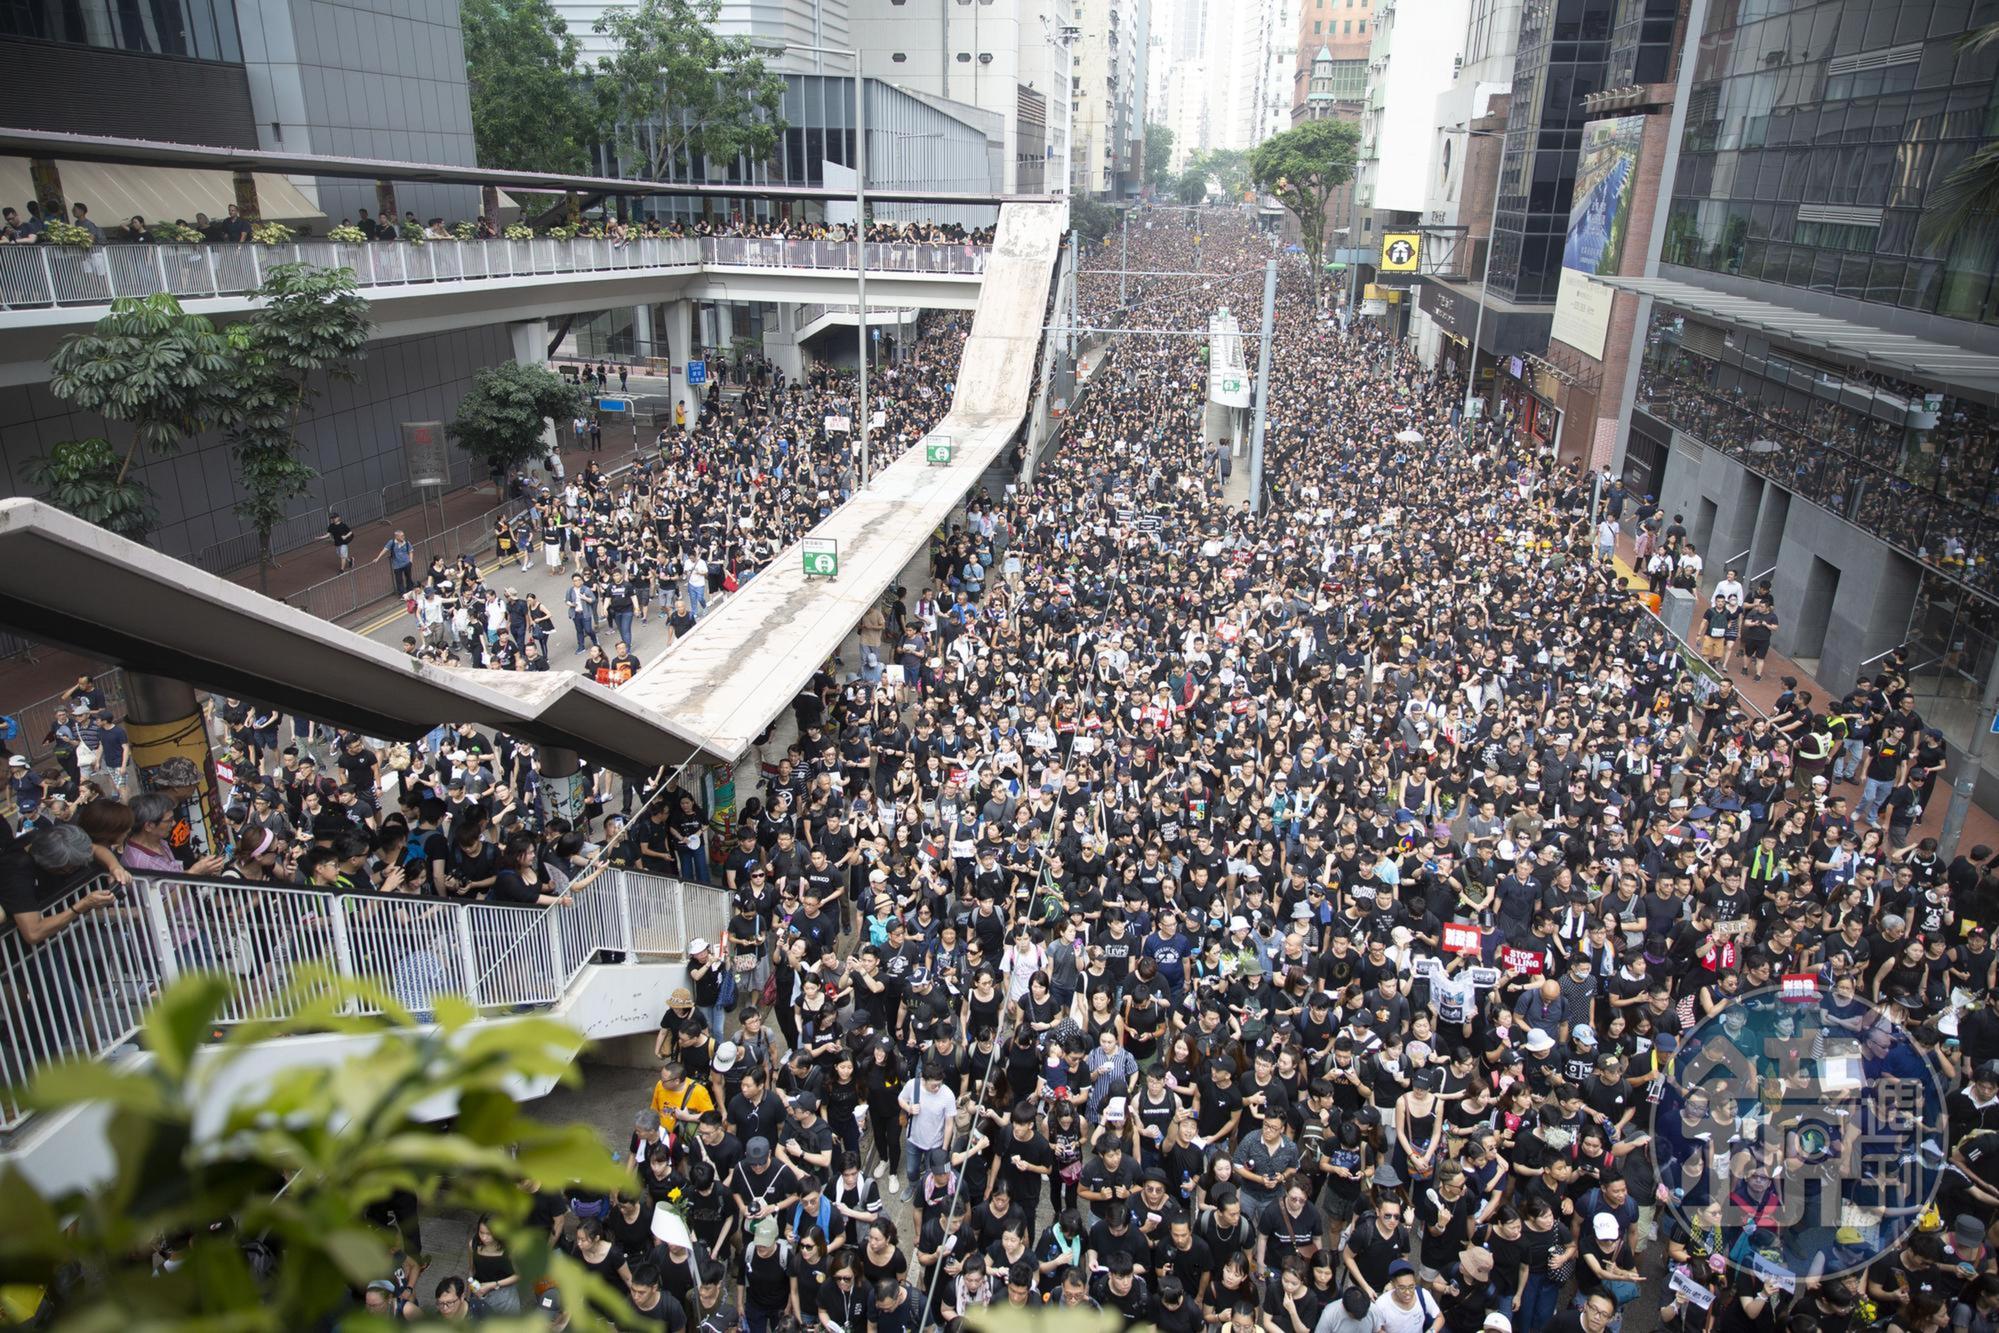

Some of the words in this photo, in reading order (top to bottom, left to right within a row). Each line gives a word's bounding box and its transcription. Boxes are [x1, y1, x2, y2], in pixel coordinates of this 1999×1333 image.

[1510, 949, 1534, 960] STOP
[1504, 955, 1539, 968] KILLING
[1514, 965, 1527, 974] US
